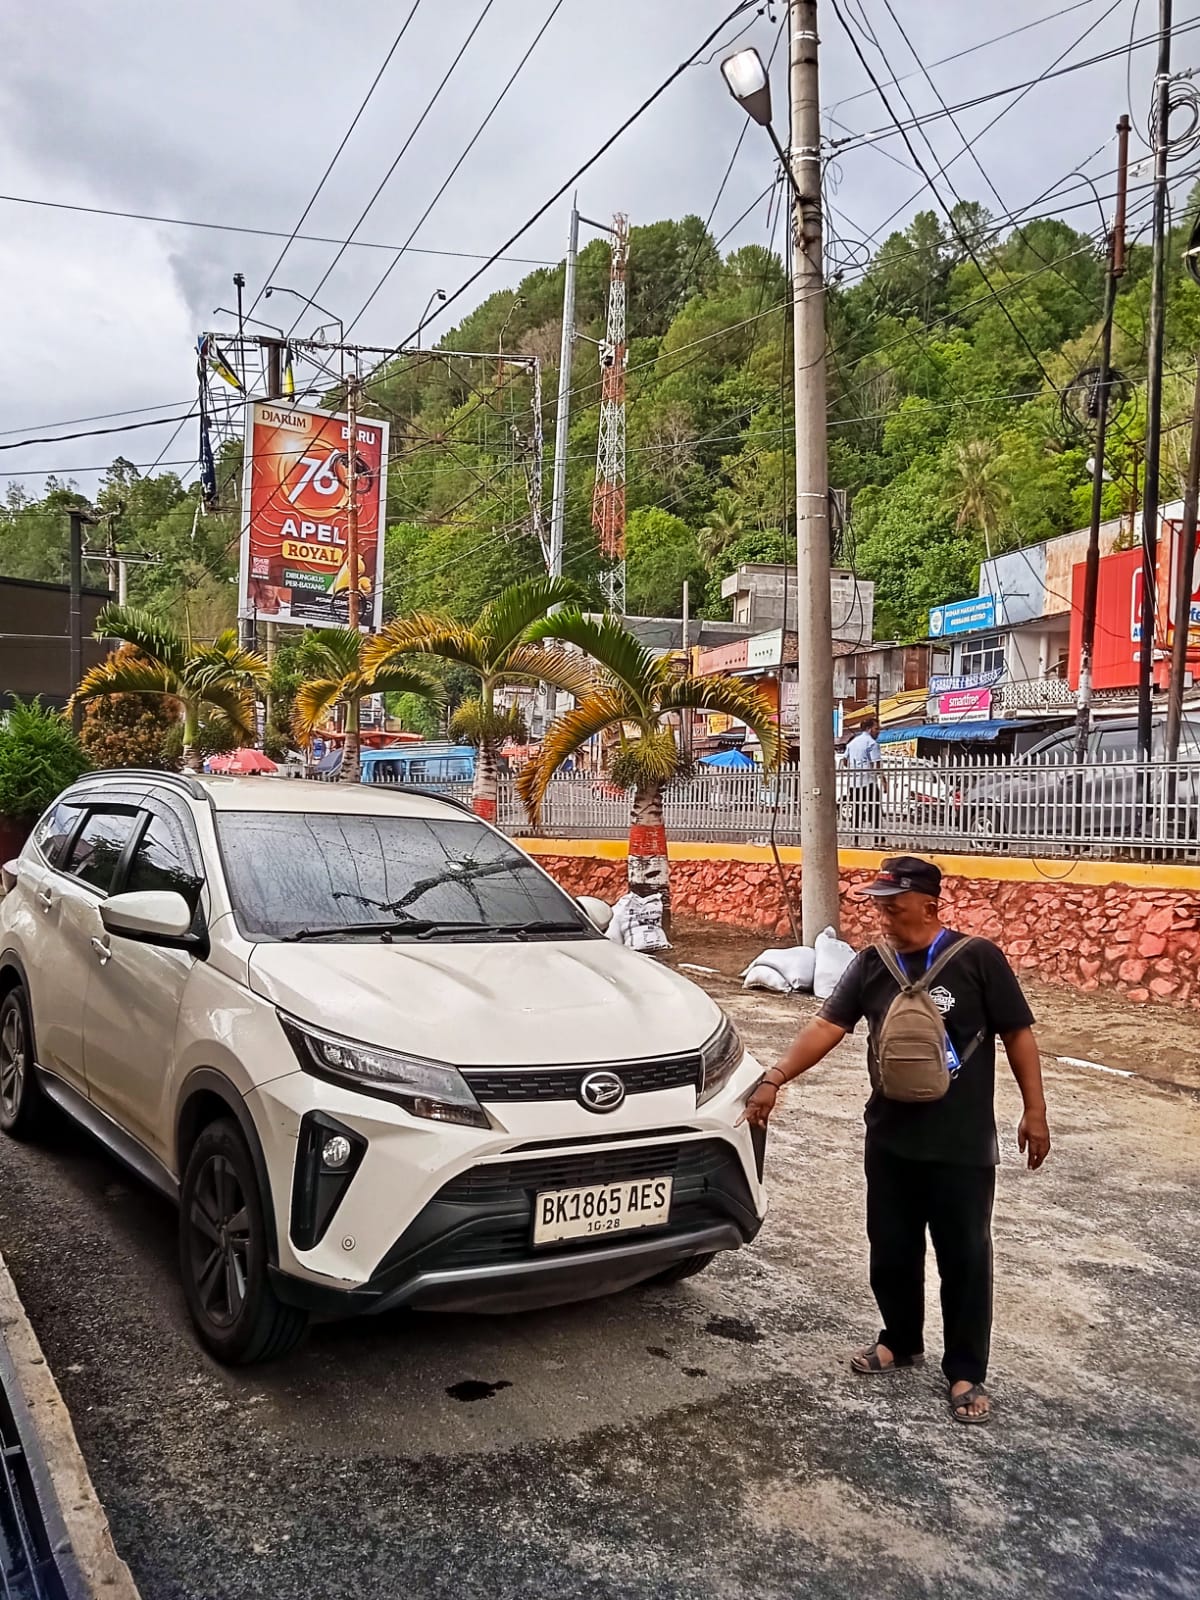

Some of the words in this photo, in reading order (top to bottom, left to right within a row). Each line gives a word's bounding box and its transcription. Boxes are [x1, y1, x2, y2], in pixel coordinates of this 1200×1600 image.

[261, 410, 306, 429] DJARUM
[341, 426, 376, 446] BRU
[288, 449, 341, 504] 76
[280, 519, 347, 545] APEL
[288, 543, 339, 562] ROYAL
[285, 571, 325, 583] DIBUNGKUS
[627, 1182, 666, 1212] AES
